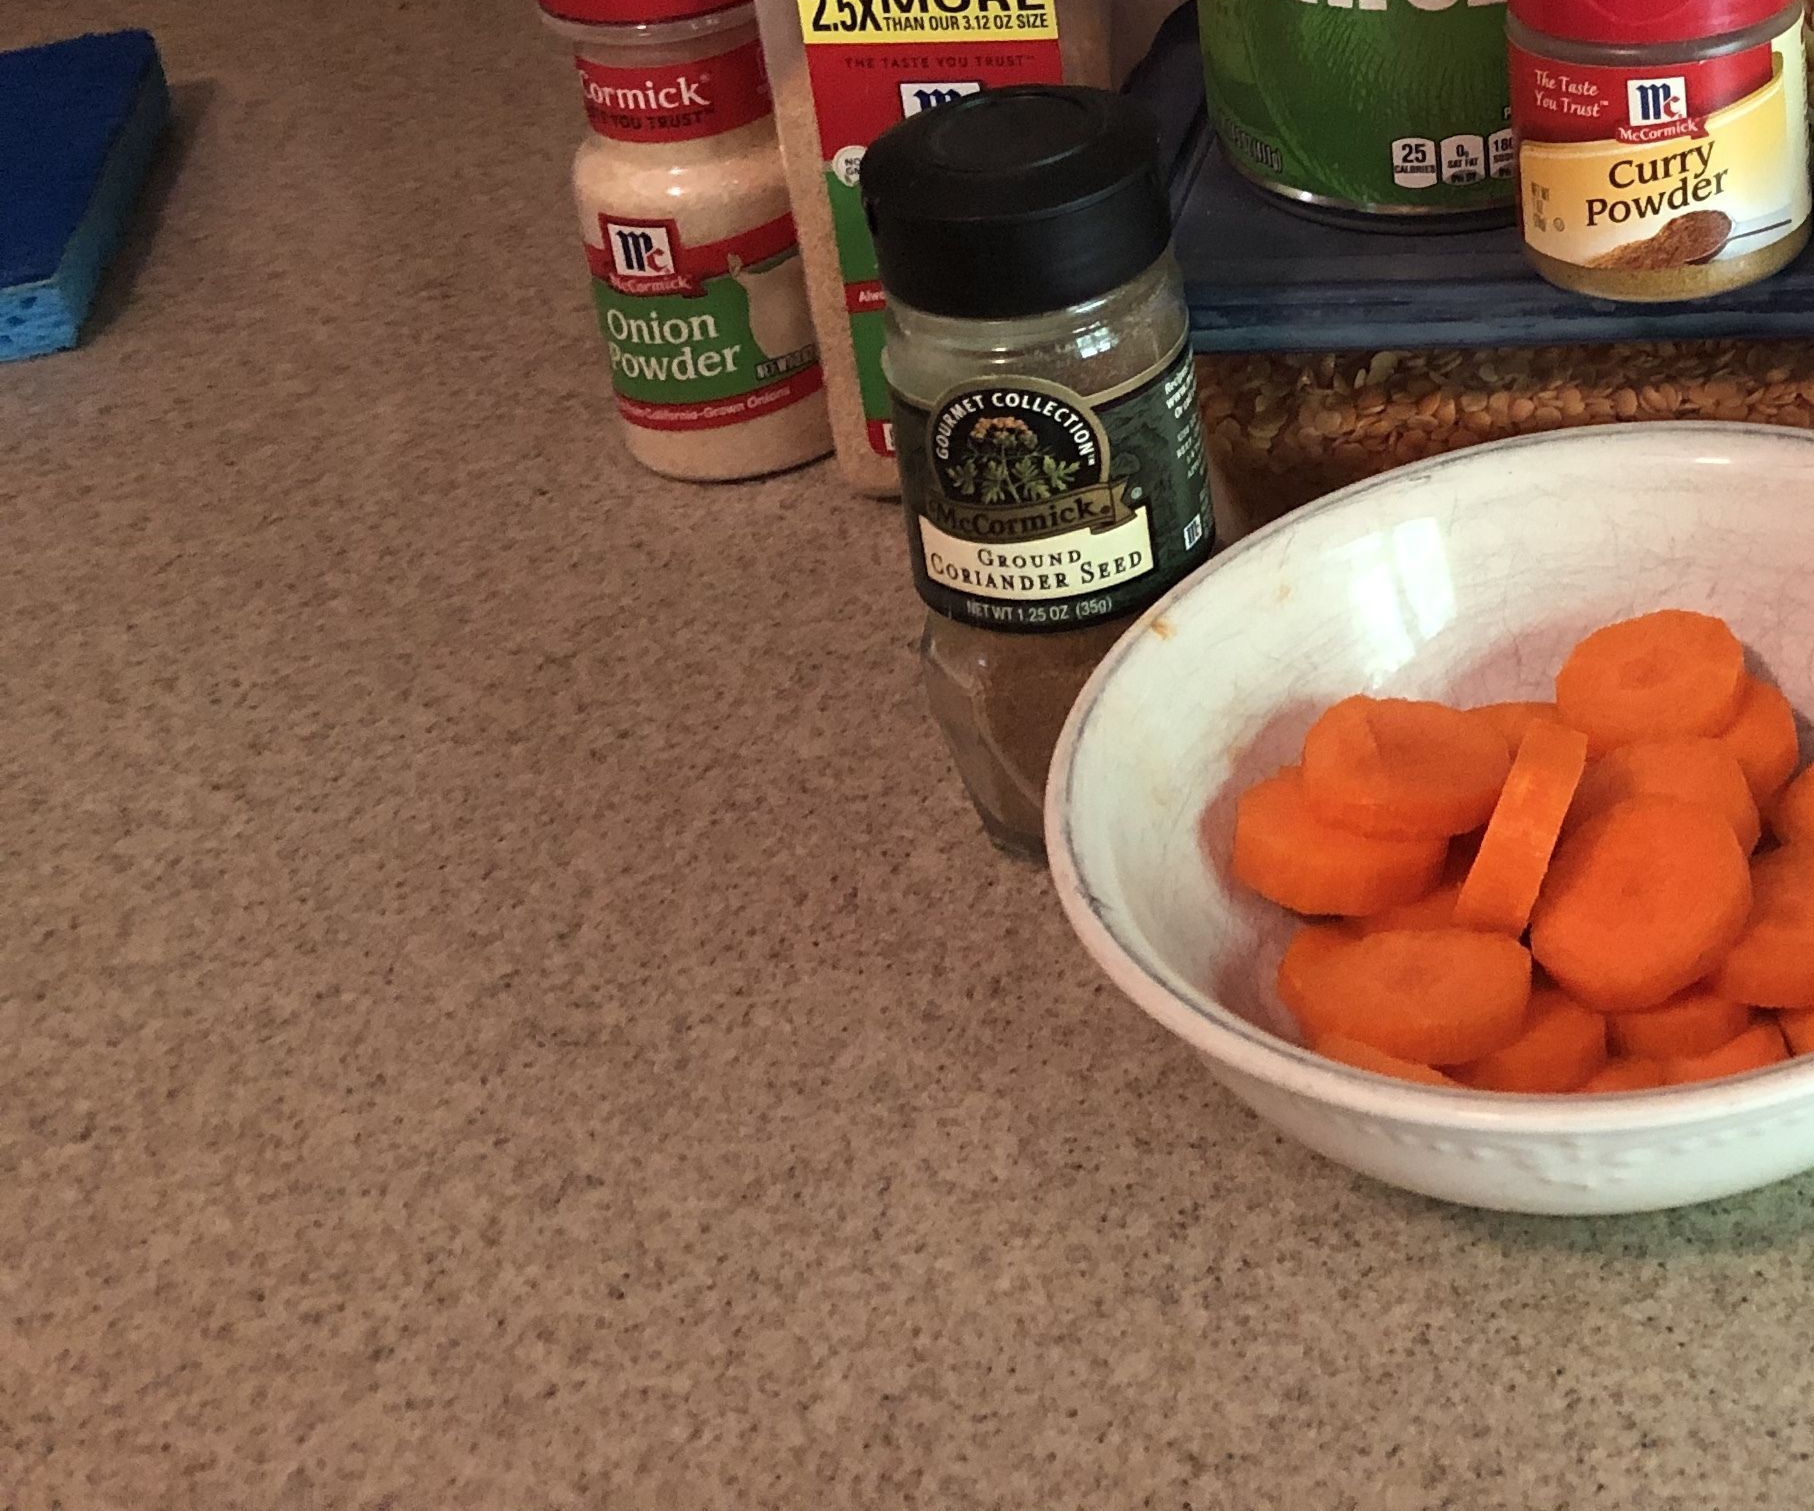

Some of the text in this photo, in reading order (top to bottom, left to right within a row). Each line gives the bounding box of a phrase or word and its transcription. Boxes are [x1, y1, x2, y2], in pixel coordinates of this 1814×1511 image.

[883, 13, 1049, 31] THAN OUR 3.12 OZ SIZE
[845, 58, 874, 69] THE
[881, 58, 930, 68] TASTE
[937, 57, 968, 68] YOU
[1534, 70, 1598, 96] The Taste
[1535, 91, 1557, 110] You
[1618, 120, 1698, 141] McCormick
[1402, 144, 1426, 163] 25
[1609, 141, 1715, 188] Curry
[1586, 168, 1728, 226] Powder
[607, 309, 719, 344] Onion
[609, 345, 741, 380] Powder
[936, 392, 1095, 460] GOURMET COLLECTION
[937, 498, 1097, 534] McCormick
[977, 548, 1081, 567] GROUND
[931, 551, 1141, 591] CORIANDER SEED
[967, 597, 1112, 622] NET WT 1.25 OZ (35g)
